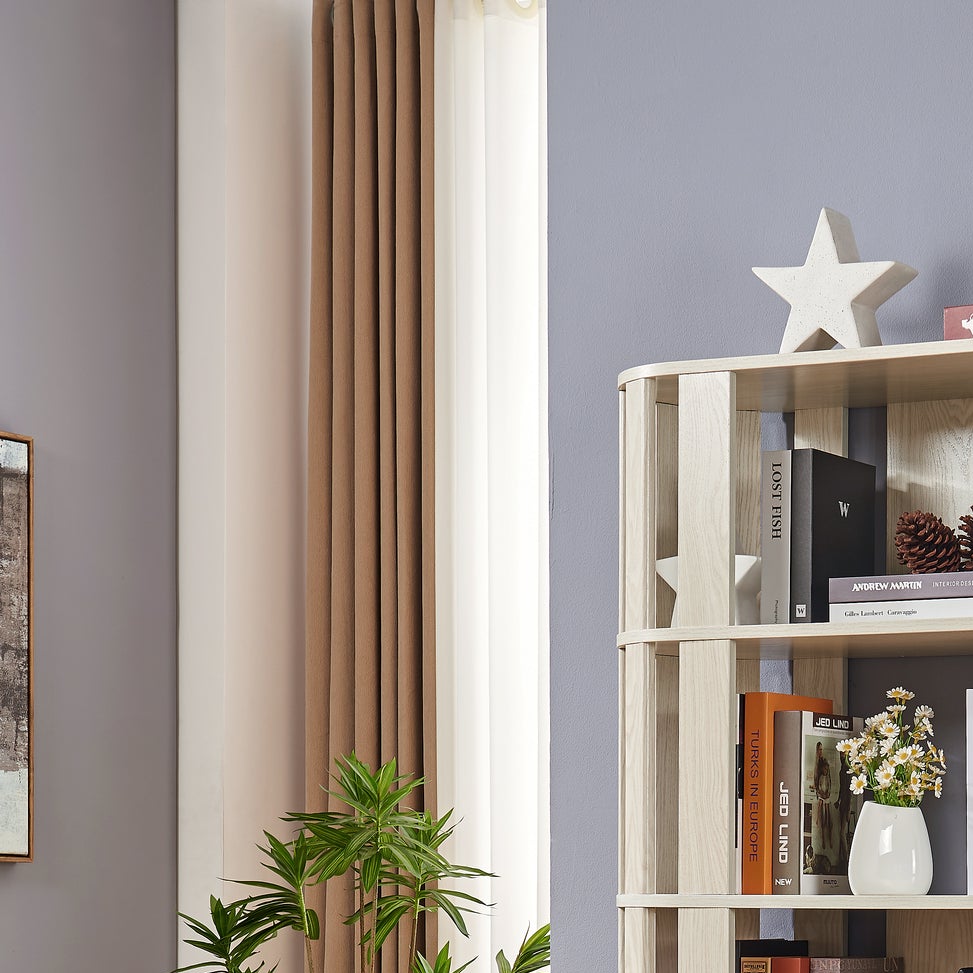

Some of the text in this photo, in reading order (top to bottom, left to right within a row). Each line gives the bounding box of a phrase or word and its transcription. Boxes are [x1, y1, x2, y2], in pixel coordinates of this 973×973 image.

[771, 462, 782, 540] LOST FISH
[838, 500, 850, 518] W
[852, 581, 922, 592] ANDREW MARTIN
[797, 607, 805, 615] W
[815, 717, 849, 729] JED LIND
[750, 730, 760, 862] TURKS IN EUROPE
[778, 781, 789, 864] JED LIND
[775, 878, 792, 886] NEW
